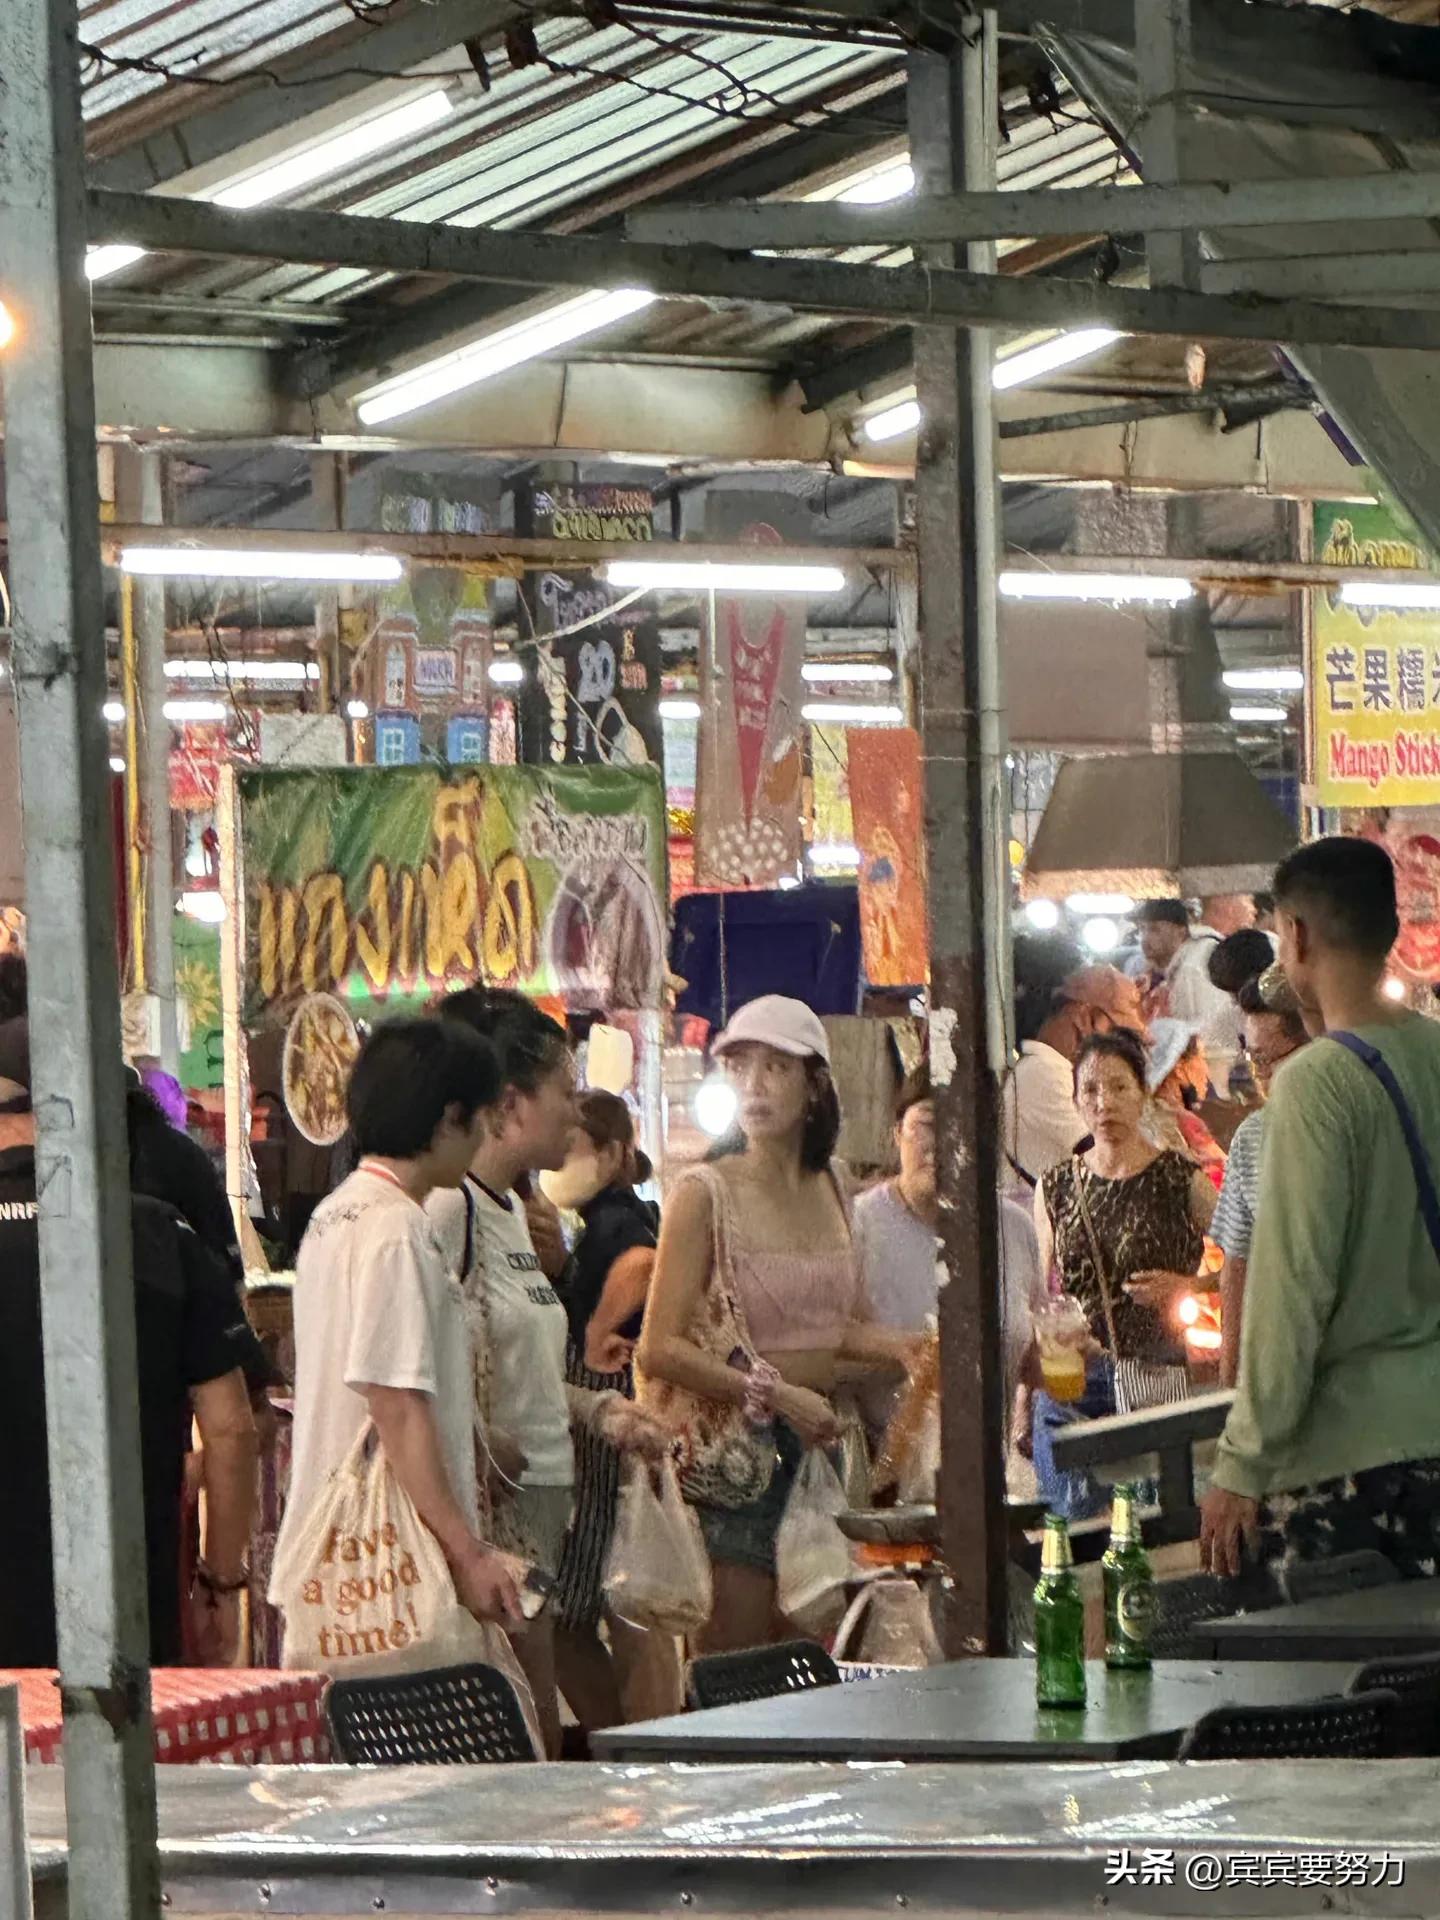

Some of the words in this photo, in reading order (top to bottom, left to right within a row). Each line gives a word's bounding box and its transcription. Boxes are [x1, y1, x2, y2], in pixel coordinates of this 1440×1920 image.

[1329, 732, 1389, 788] Mango
[303, 1578, 323, 1604] a
[336, 1551, 421, 1616] good
[319, 1601, 421, 1657] time!
